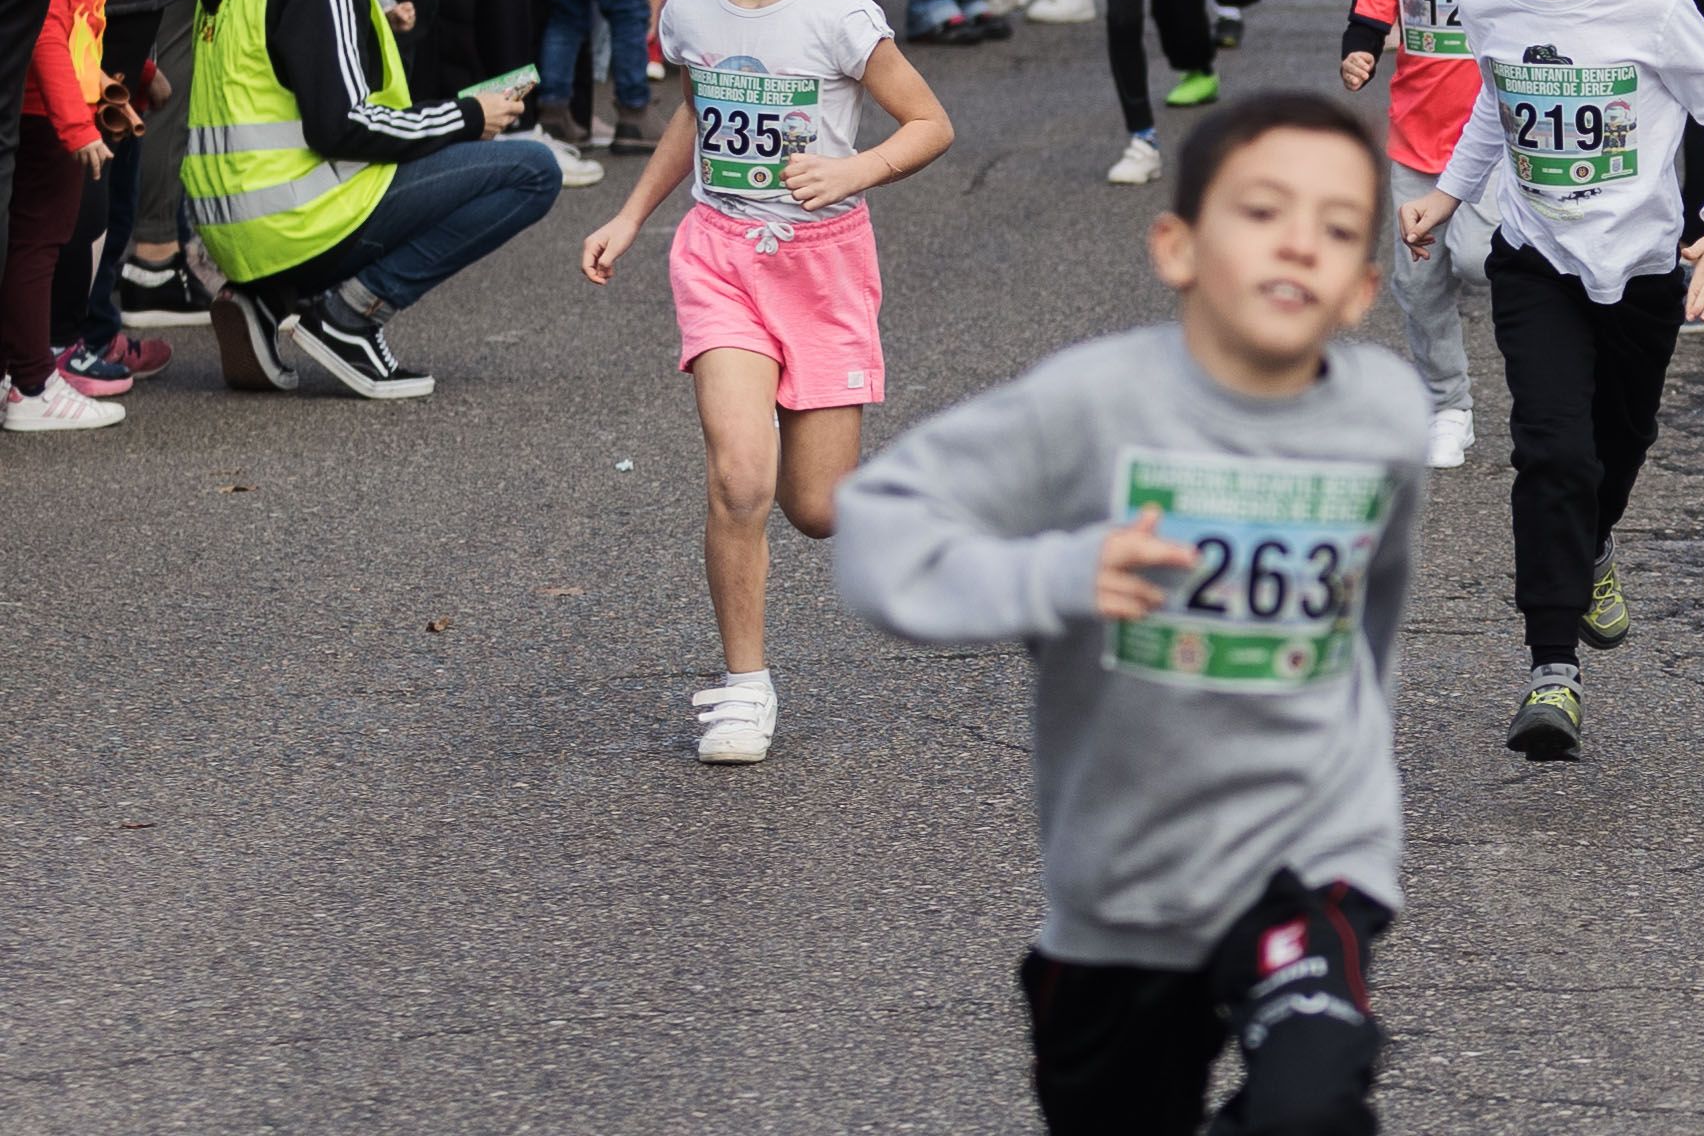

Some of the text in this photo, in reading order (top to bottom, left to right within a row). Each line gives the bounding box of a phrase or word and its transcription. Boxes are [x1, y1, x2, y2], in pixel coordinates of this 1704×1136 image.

[719, 72, 762, 90] INFANTIL
[1531, 67, 1580, 83] INFANTIL
[698, 82, 794, 105] BOMBEROS DE JEREZ
[1505, 78, 1614, 97] BOMBEROS DE JEREZ
[702, 106, 782, 158] 235
[1515, 102, 1603, 151] 219
[1187, 537, 1339, 619] 263
